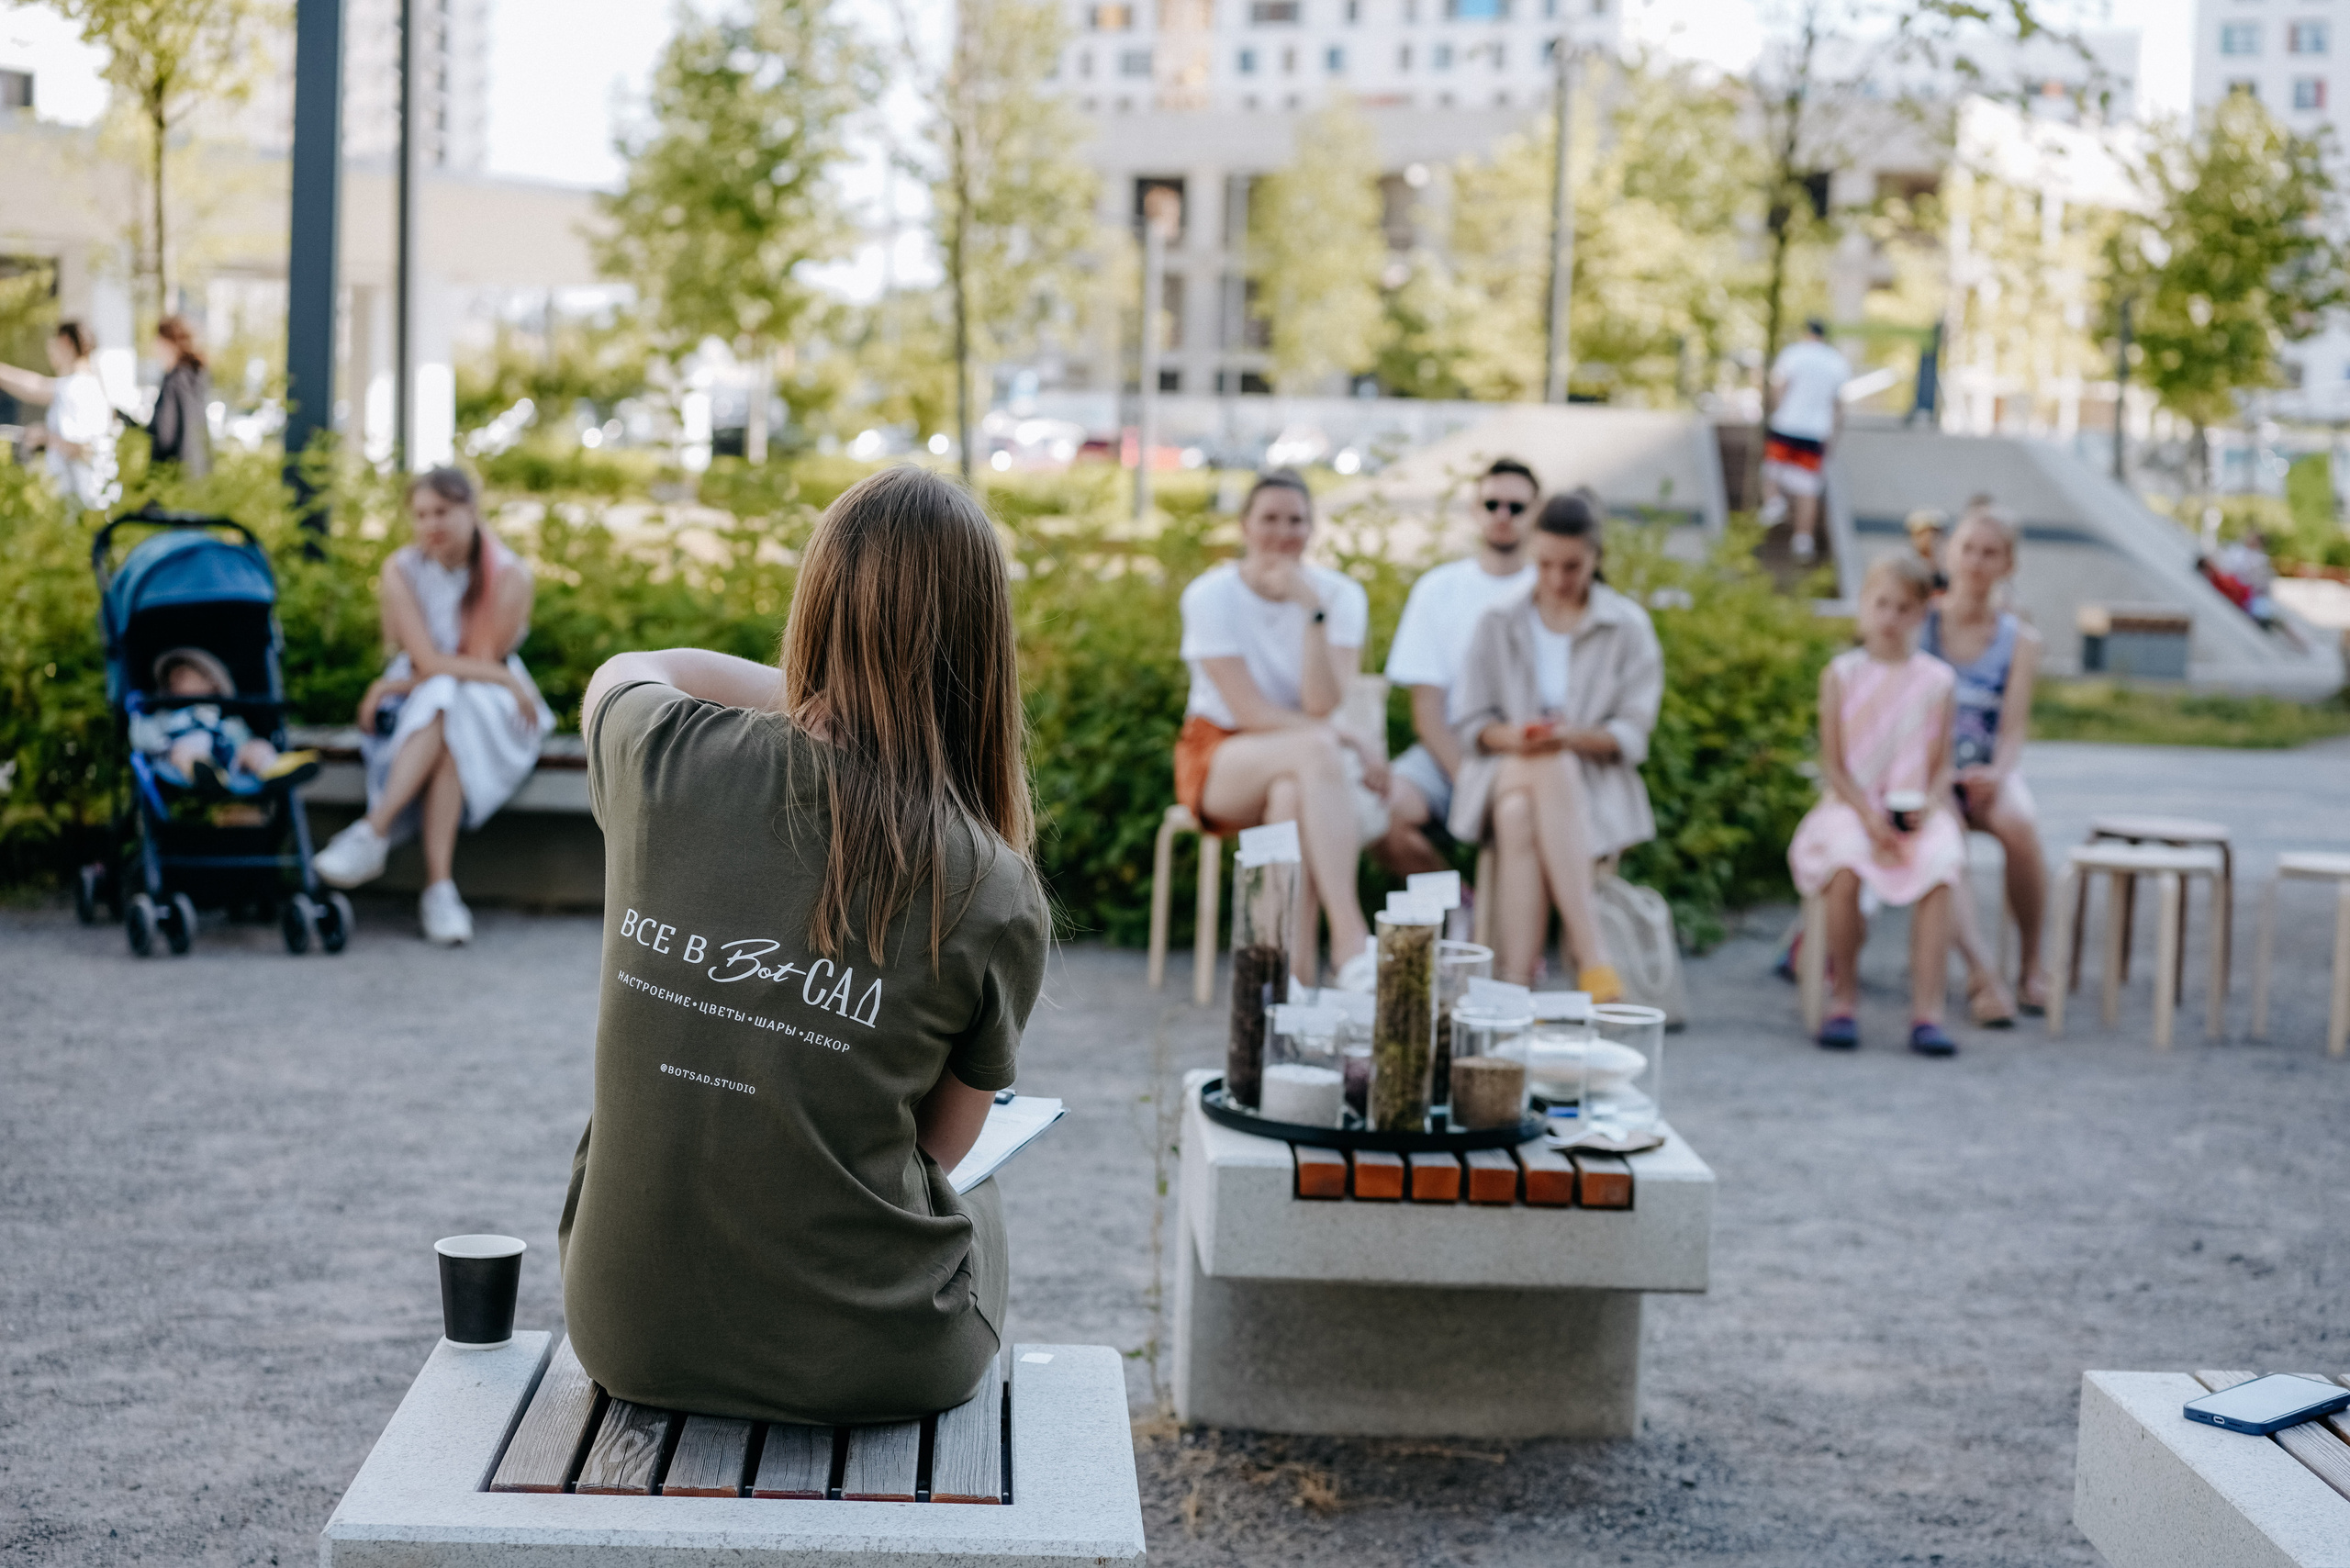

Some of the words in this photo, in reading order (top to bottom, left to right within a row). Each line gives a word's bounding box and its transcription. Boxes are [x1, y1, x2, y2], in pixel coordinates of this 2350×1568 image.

[619, 907, 677, 955] ВСЕ
[682, 934, 708, 964] В
[707, 938, 807, 983] Bot
[802, 958, 882, 1029] САД
[659, 1063, 756, 1095] @BOTSAD.STUDIO
